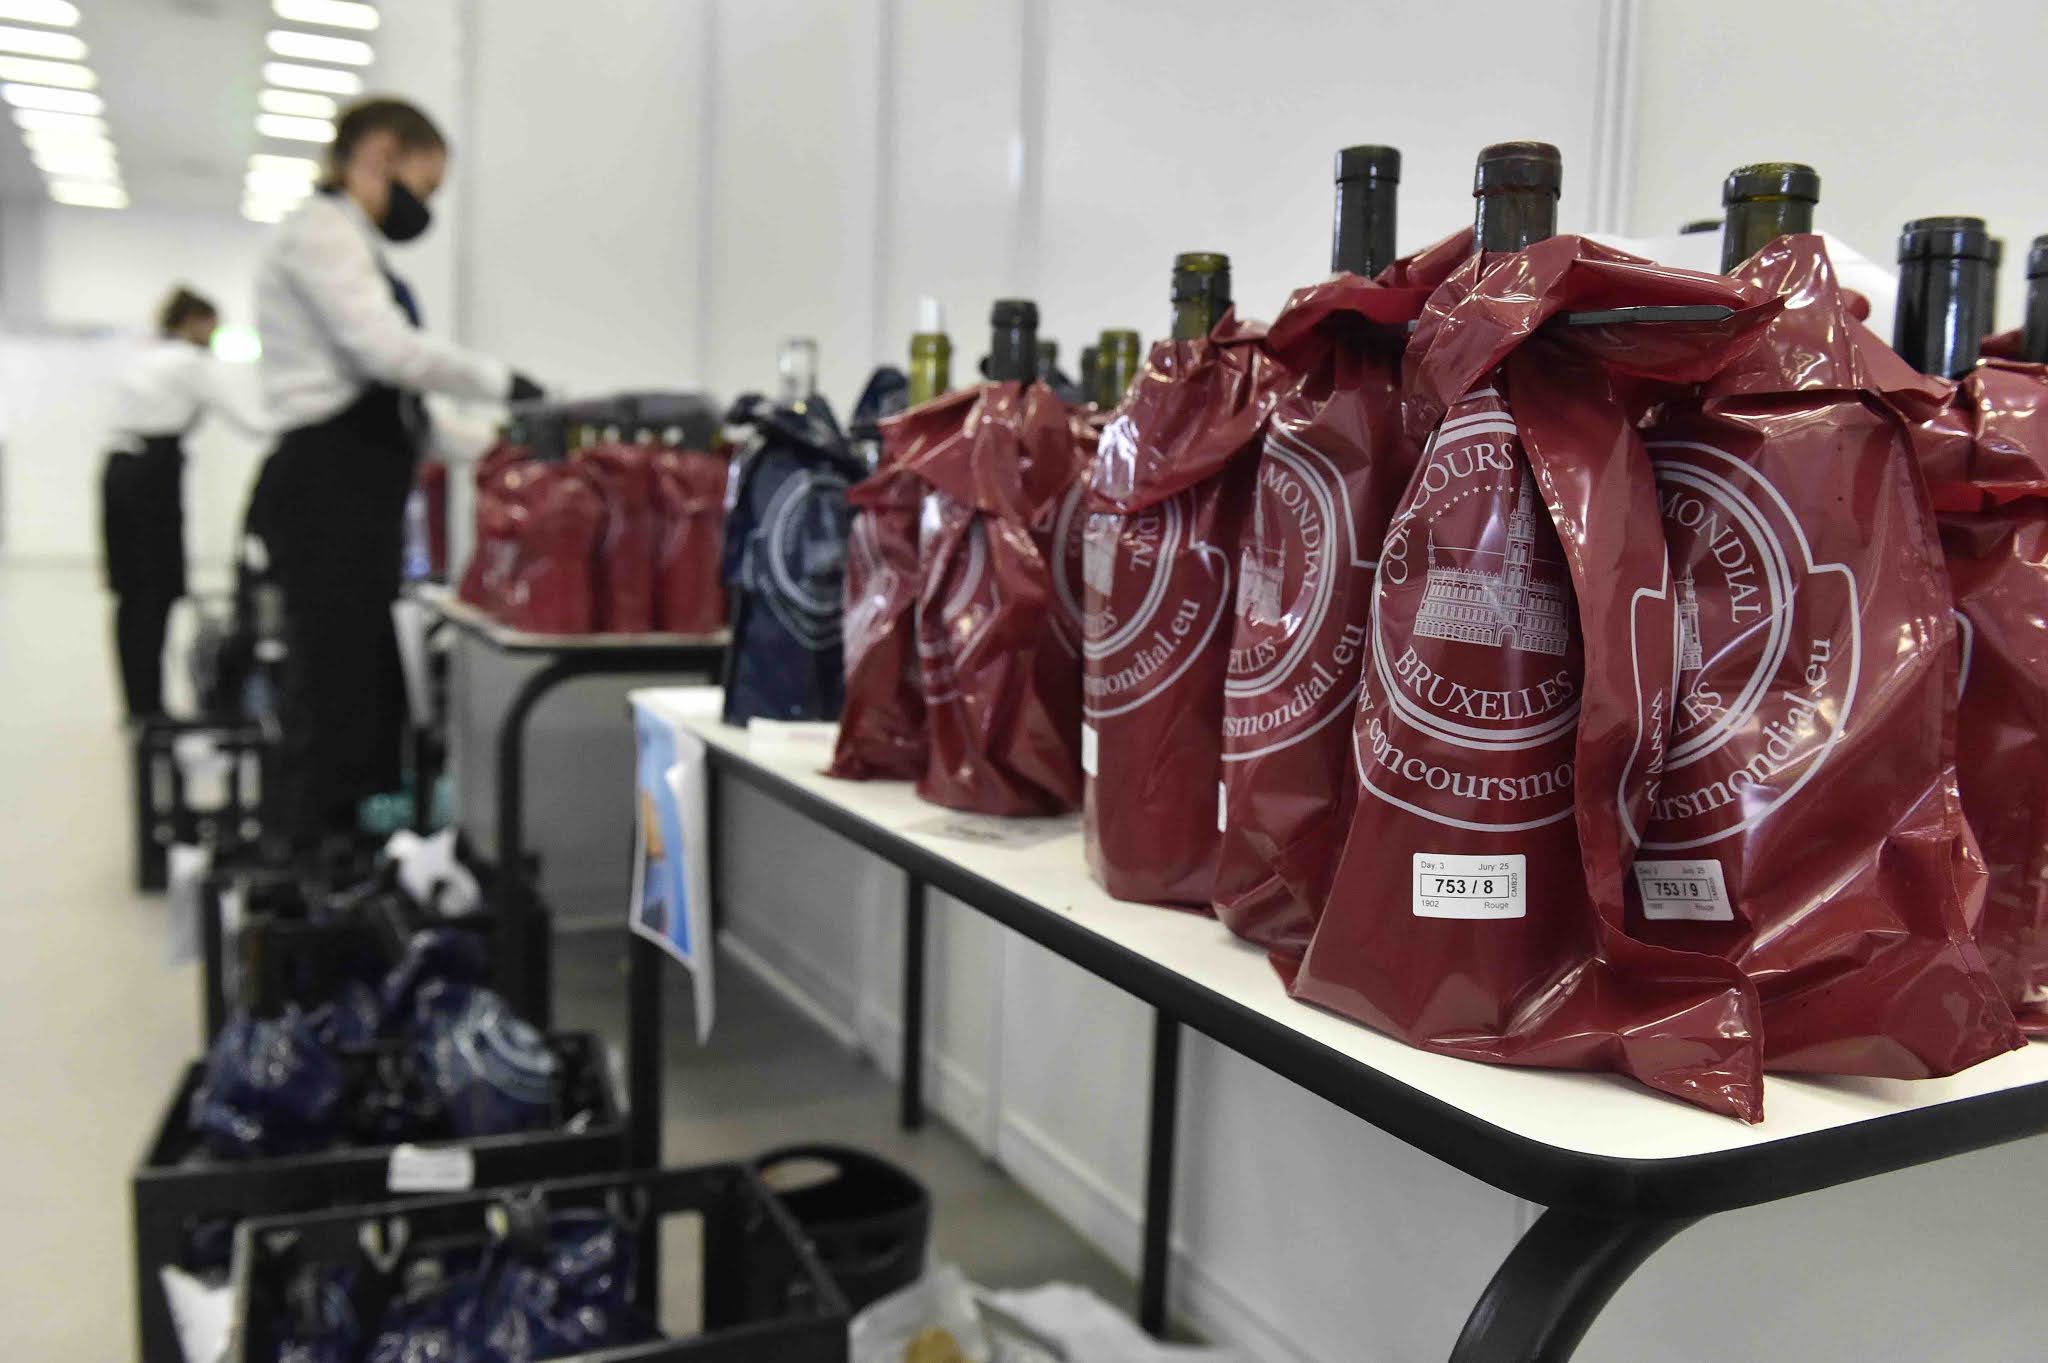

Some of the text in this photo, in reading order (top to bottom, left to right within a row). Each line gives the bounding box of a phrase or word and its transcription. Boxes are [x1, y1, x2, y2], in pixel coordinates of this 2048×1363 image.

[1262, 464, 1321, 593] MONDIAL
[1657, 487, 1763, 624] MONDIAL
[1394, 645, 1576, 722] BRUXELLES
[1439, 862, 1445, 870] 3
[1499, 862, 1510, 871] 25
[1435, 878, 1494, 894] 753 / 8
[1654, 883, 1680, 896] 753
[1689, 883, 1699, 896] 9
[1421, 899, 1509, 910] 1902 Rouge
